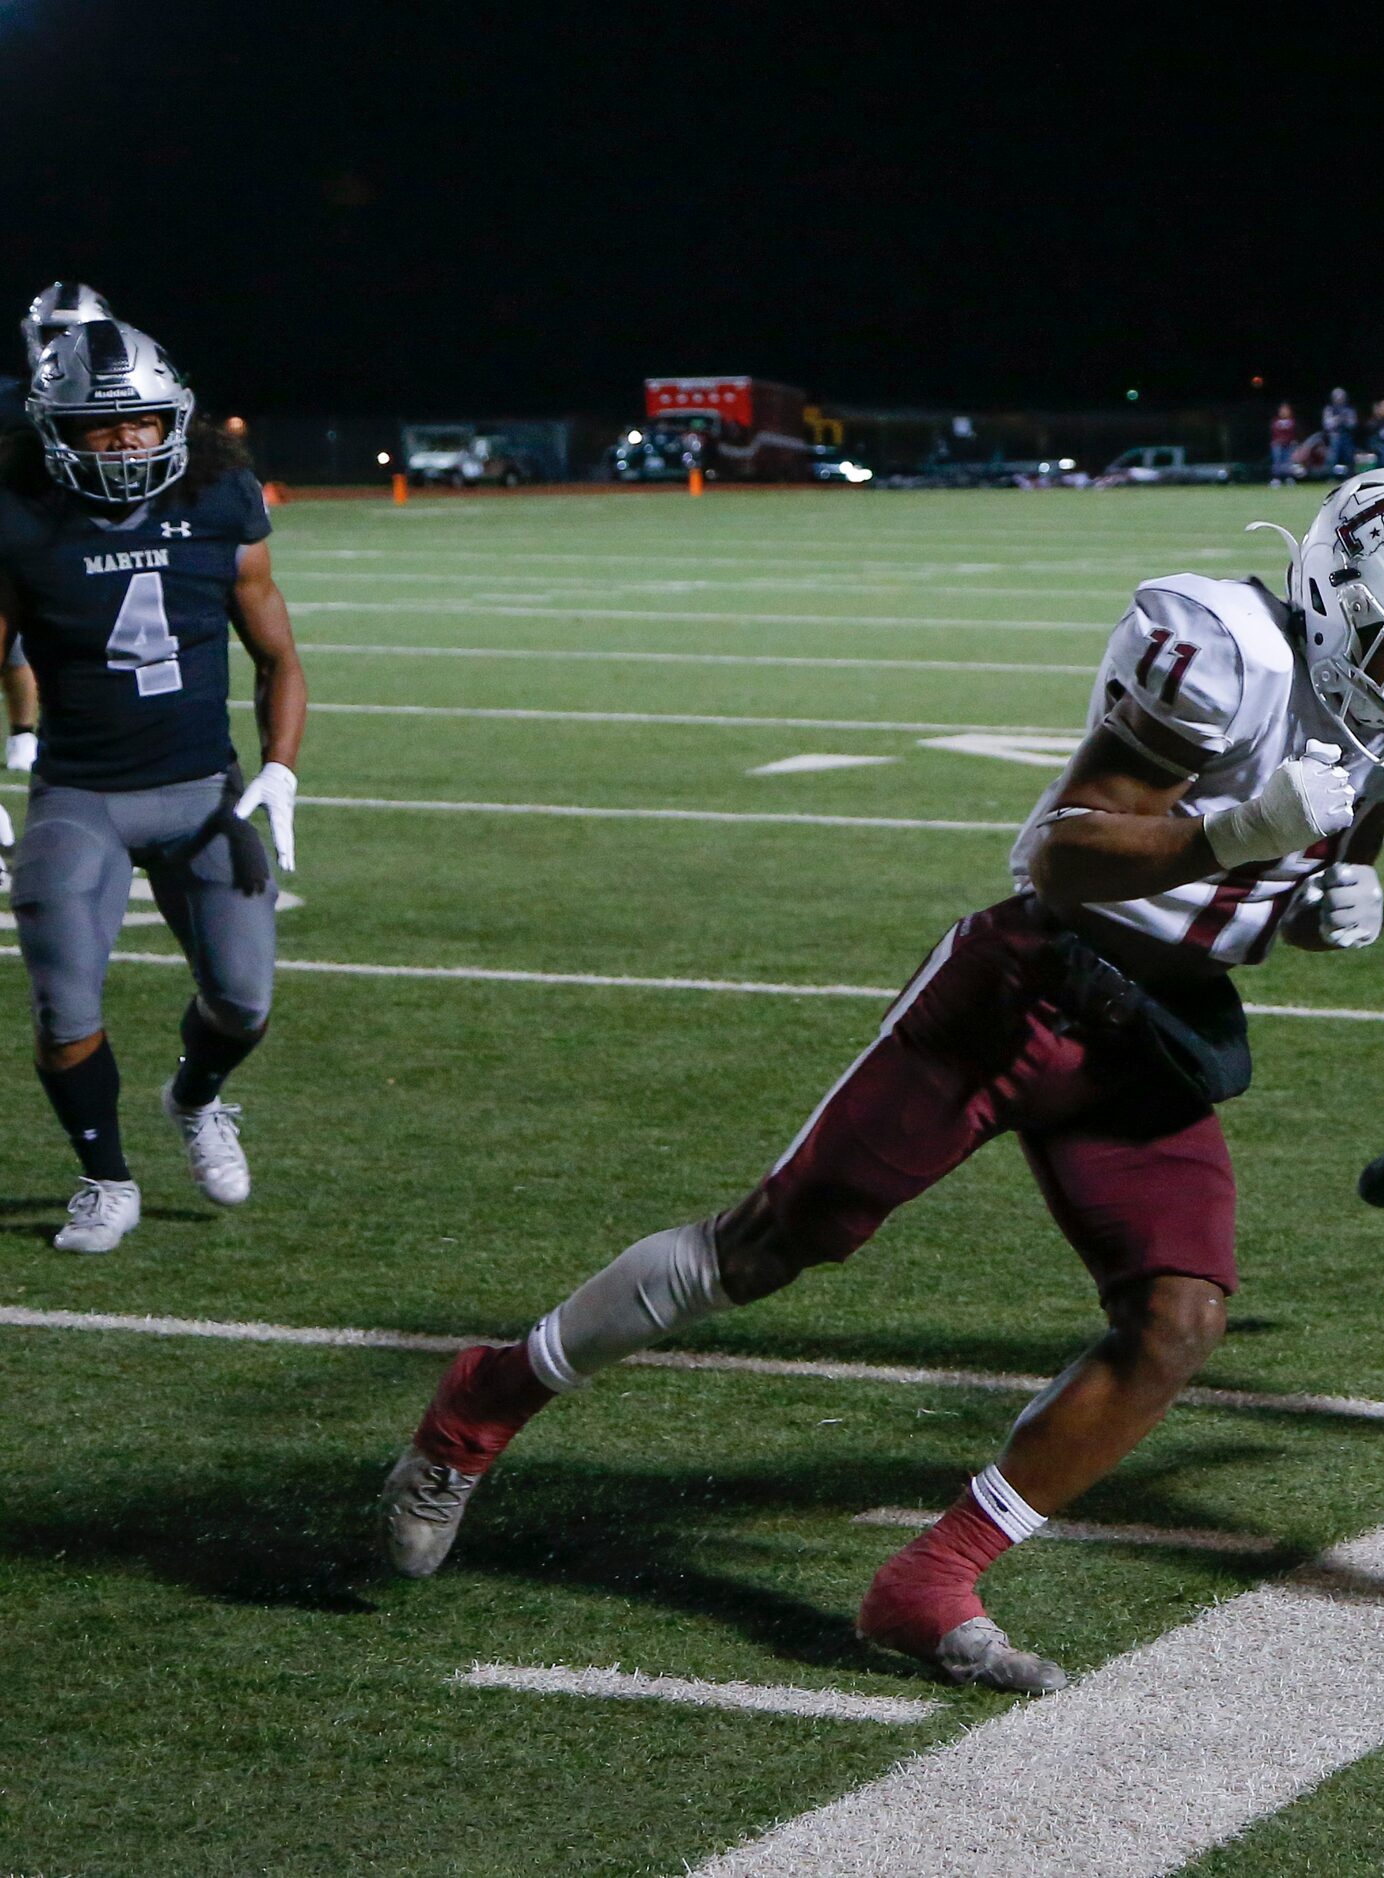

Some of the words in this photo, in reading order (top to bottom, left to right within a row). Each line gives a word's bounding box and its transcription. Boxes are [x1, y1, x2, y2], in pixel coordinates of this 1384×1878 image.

[83, 549, 169, 575] MARTIN
[105, 571, 183, 697] 4
[1135, 626, 1202, 706] 11
